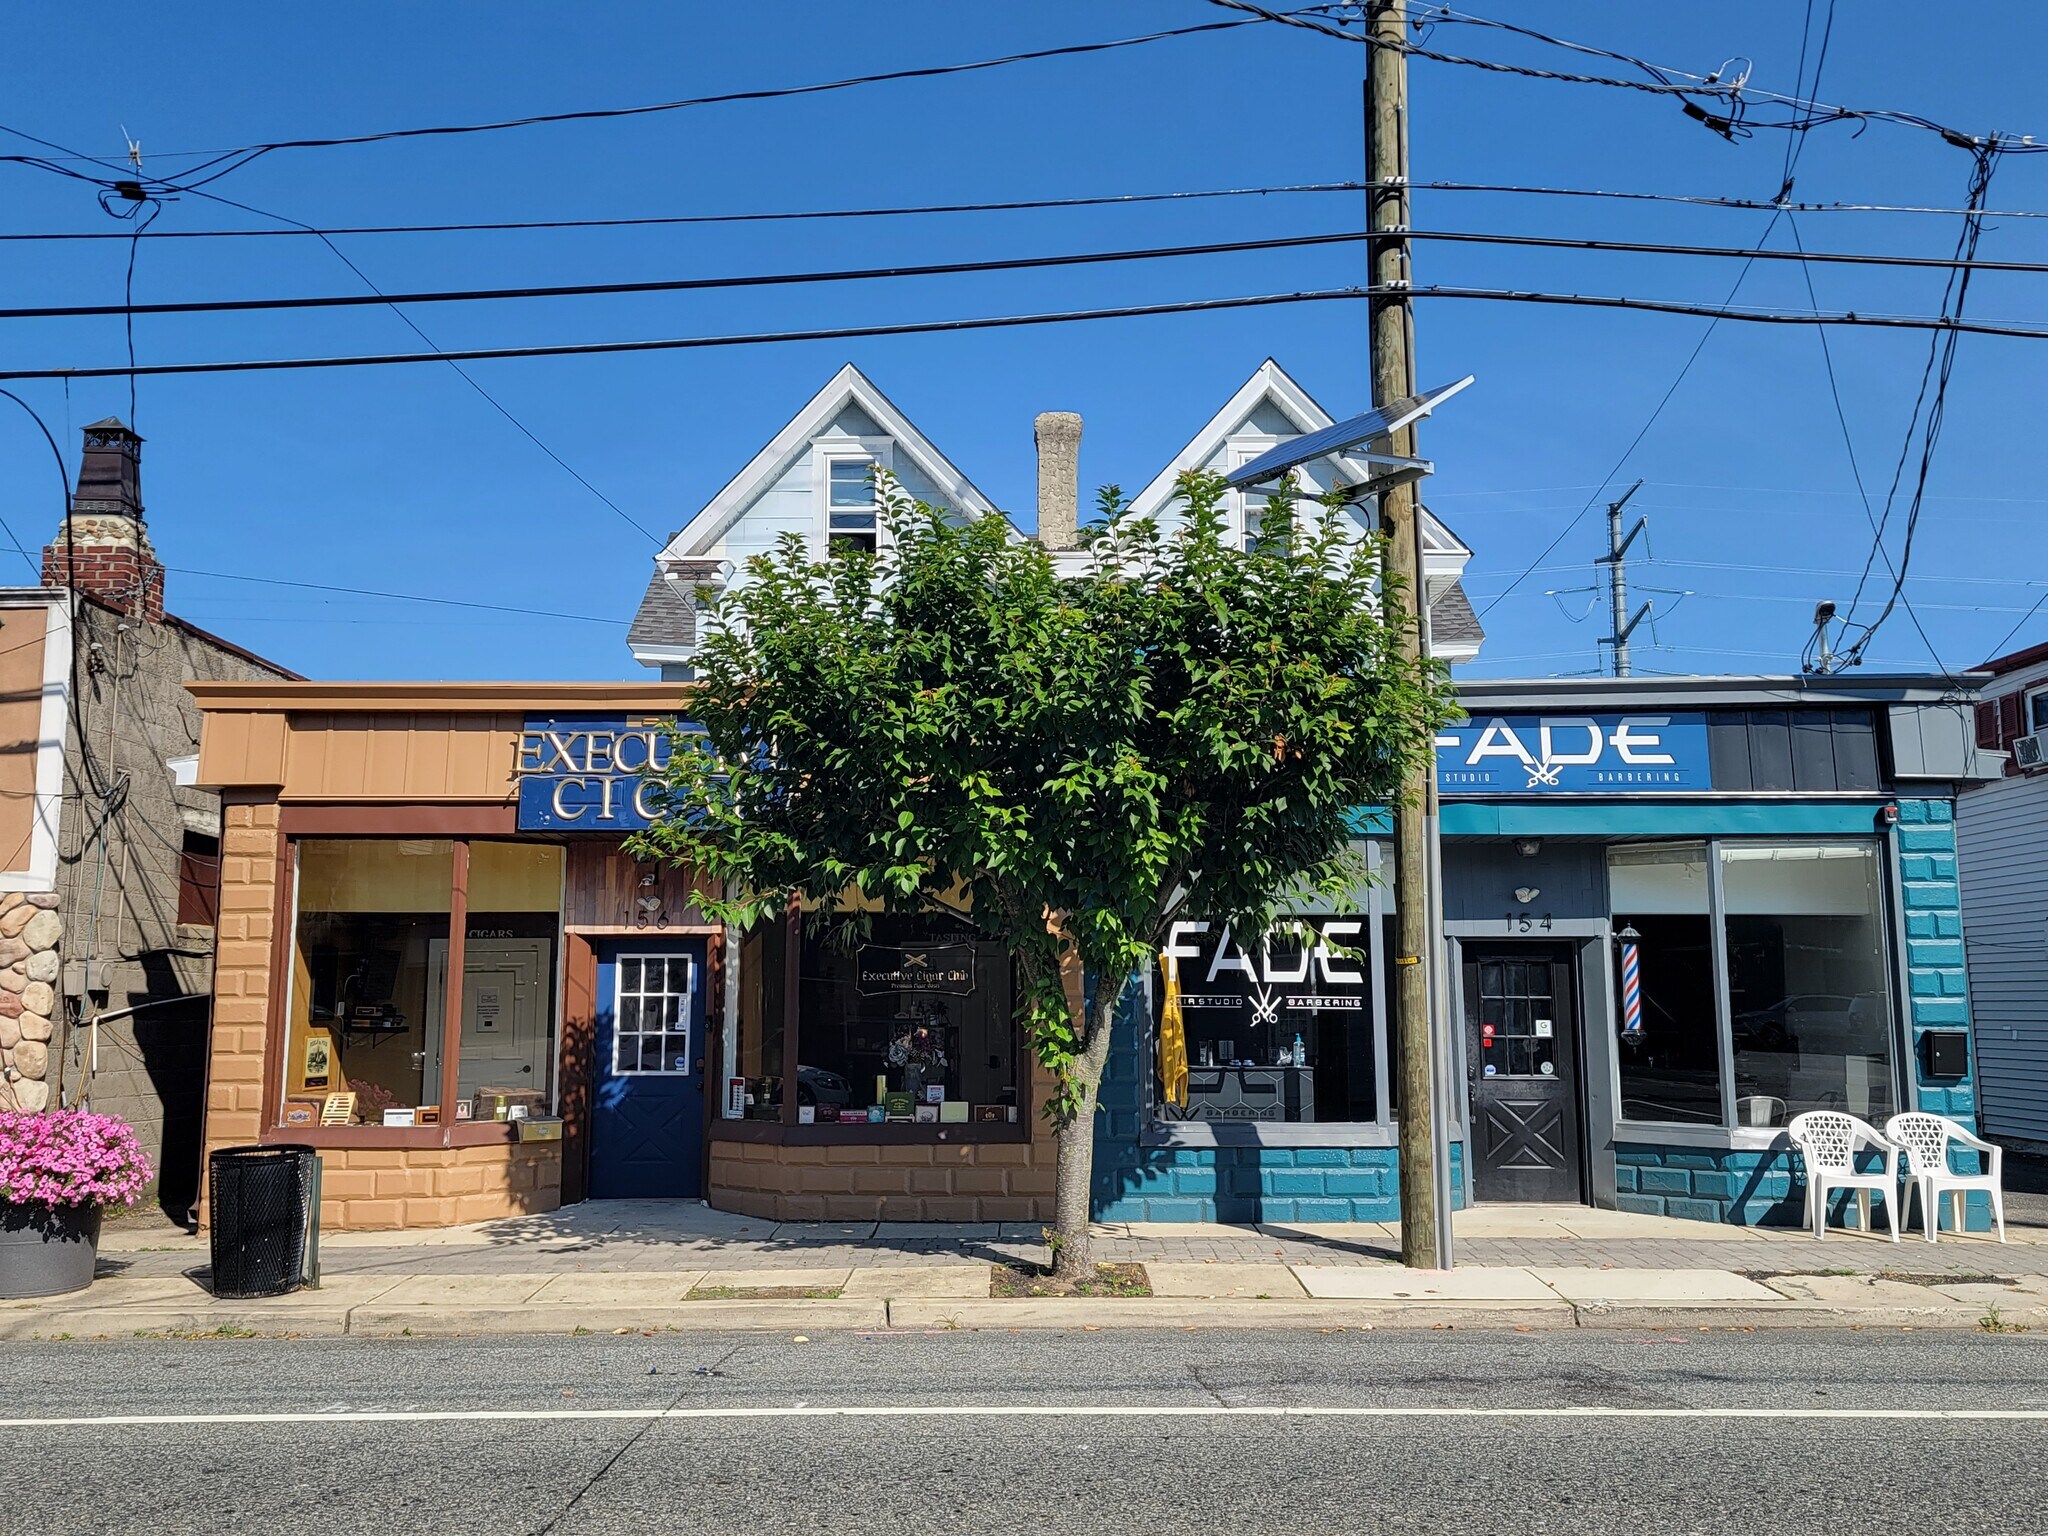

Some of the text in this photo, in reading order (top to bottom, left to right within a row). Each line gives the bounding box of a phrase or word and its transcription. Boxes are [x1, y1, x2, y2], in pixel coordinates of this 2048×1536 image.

[1445, 772, 1681, 783] STUDIO BARBERING
[624, 910, 669, 930] 156
[1506, 912, 1553, 933] 154
[469, 929, 514, 938] CIGARS
[1162, 921, 1364, 984] FADE
[1199, 998, 1243, 1006] STUDIO
[1287, 998, 1361, 1007] BARBERING
